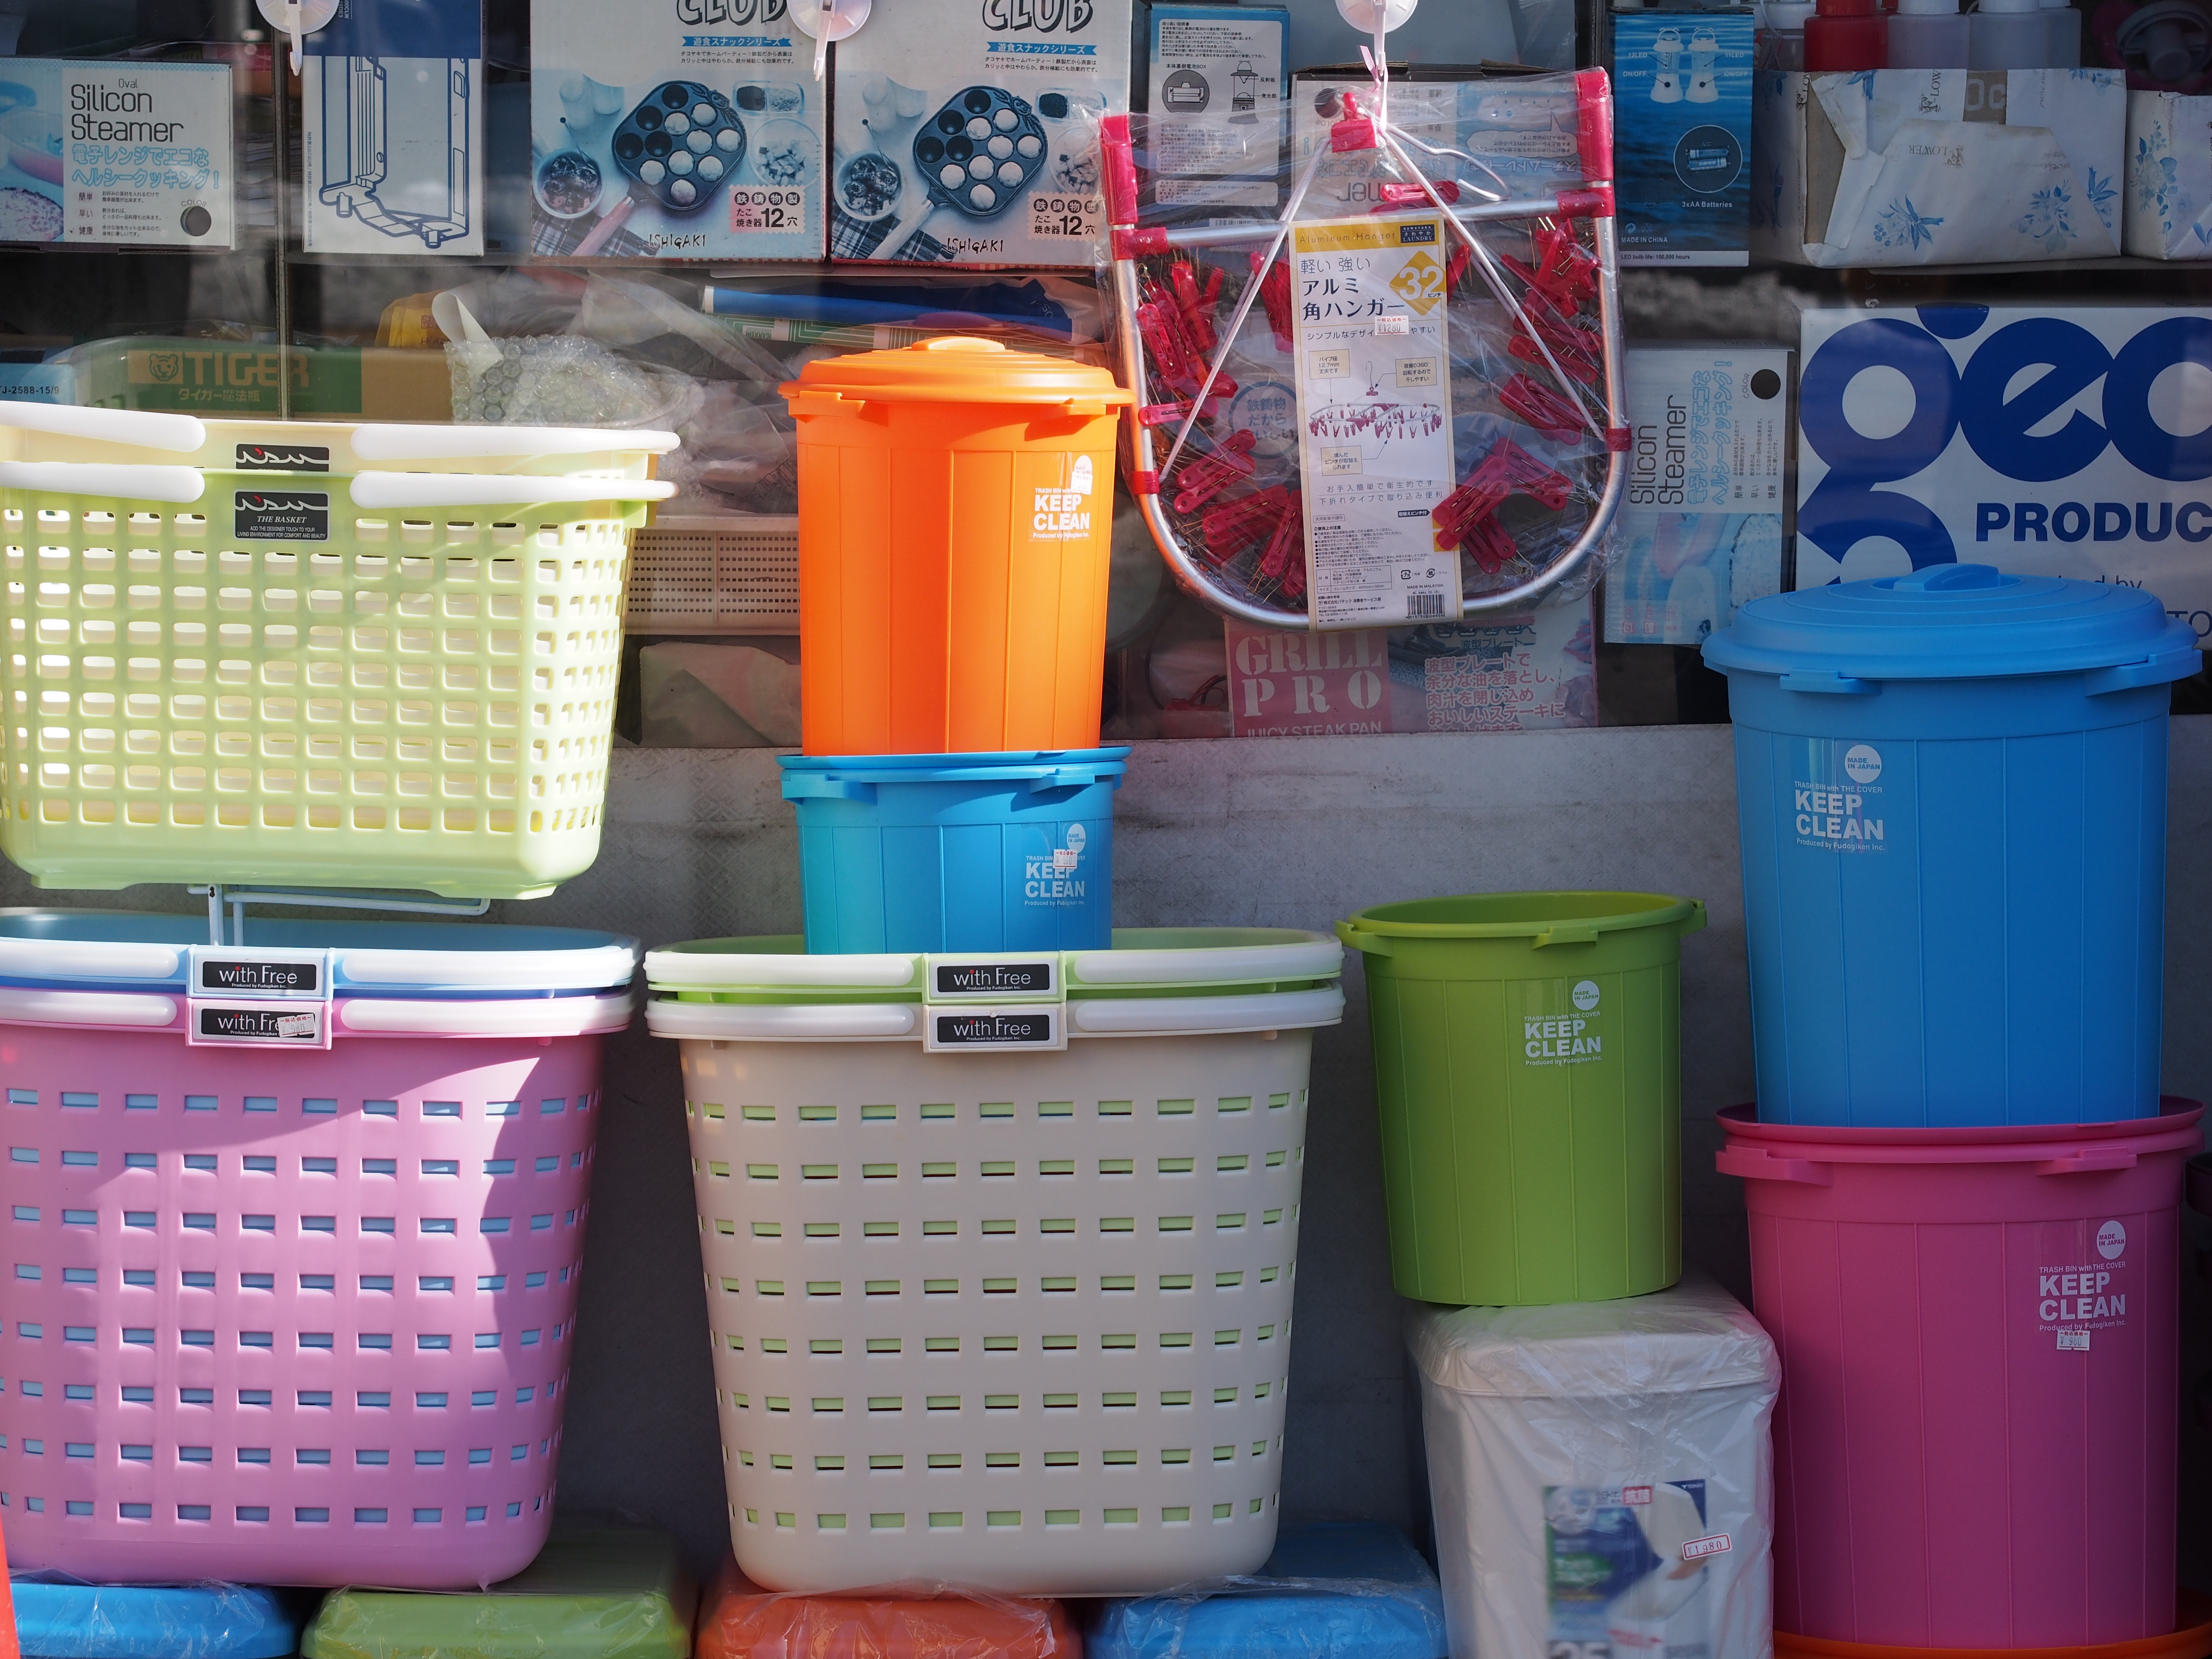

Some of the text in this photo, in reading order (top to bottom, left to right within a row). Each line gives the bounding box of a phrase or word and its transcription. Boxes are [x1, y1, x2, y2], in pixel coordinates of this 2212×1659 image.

[998, 43, 1086, 54] 遊食スナックシリーズ
[119, 79, 138, 88] Oval
[71, 84, 152, 112] Silicon
[71, 114, 184, 142] Steamer
[72, 144, 209, 166] 電子レンジでエコな
[72, 168, 219, 189] ヘルシークッキング！
[79, 192, 93, 201] 簡単
[734, 192, 800, 205] 鉄鋳物製
[79, 210, 93, 218] 早い
[736, 208, 798, 228] 焼き器 12 穴
[737, 208, 752, 216] たこ
[1035, 215, 1050, 223] たこ
[79, 226, 93, 235] 健康
[1034, 216, 1095, 236] 焼き器 12 穴
[649, 233, 706, 250] ISHIGAKI
[947, 238, 1004, 254] ISHIGAKI
[1299, 232, 1395, 244] Aluminum Hanger
[1300, 257, 1370, 274] 軽い 強い
[1303, 277, 1359, 296] アルミ
[1399, 266, 1444, 301] 32
[1303, 298, 1405, 321] 角ハンガー
[183, 351, 309, 387] TIGER
[0, 386, 60, 394] J-2588-15/9
[179, 388, 260, 403] タイガー魔法瓶
[1248, 413, 1286, 426] だから
[1687, 371, 1711, 505] 電子レンジでエコな
[1712, 361, 1733, 505] ヘルシークッキング！
[1658, 394, 1687, 505] Steamer
[1631, 425, 1658, 505] Silicon
[1327, 480, 1433, 493] お手入簡単で衛生的です
[1734, 484, 1744, 499] 簡単
[1751, 484, 1760, 499] 早い
[1767, 484, 1777, 499] 健康
[1034, 494, 1082, 511] KEEP
[1319, 491, 1443, 505] 下折れタイプで取り込み便利
[1034, 513, 1090, 530] CLEAN
[1460, 637, 1536, 649] 波型プレート
[1236, 631, 1382, 675] GRILL
[1424, 652, 1531, 673] 波型プレートで
[1425, 668, 1556, 690] 余分な油を落とし、
[1241, 670, 1382, 717] PRO
[1426, 688, 1534, 709] 肉汁を閉じ込め
[1428, 703, 1566, 725] おいしいステーキに
[1349, 721, 1382, 734] PAN
[1794, 781, 1814, 789] TRASH
[1795, 789, 1862, 815] KEEP
[1796, 814, 1884, 841] CLEAN
[1026, 863, 1075, 878] KEEP
[1025, 881, 1085, 898] CLEAN
[219, 965, 298, 984] with Free
[953, 967, 1031, 986] with Free
[217, 1013, 255, 1031] with
[953, 1018, 1031, 1036] with Free
[1525, 1020, 1586, 1039] KEEP
[1525, 1036, 1601, 1058] CLEAN
[2106, 1261, 2126, 1269] COVER
[2040, 1272, 2110, 1296] KEEP
[2039, 1294, 2126, 1321] CLEAN
